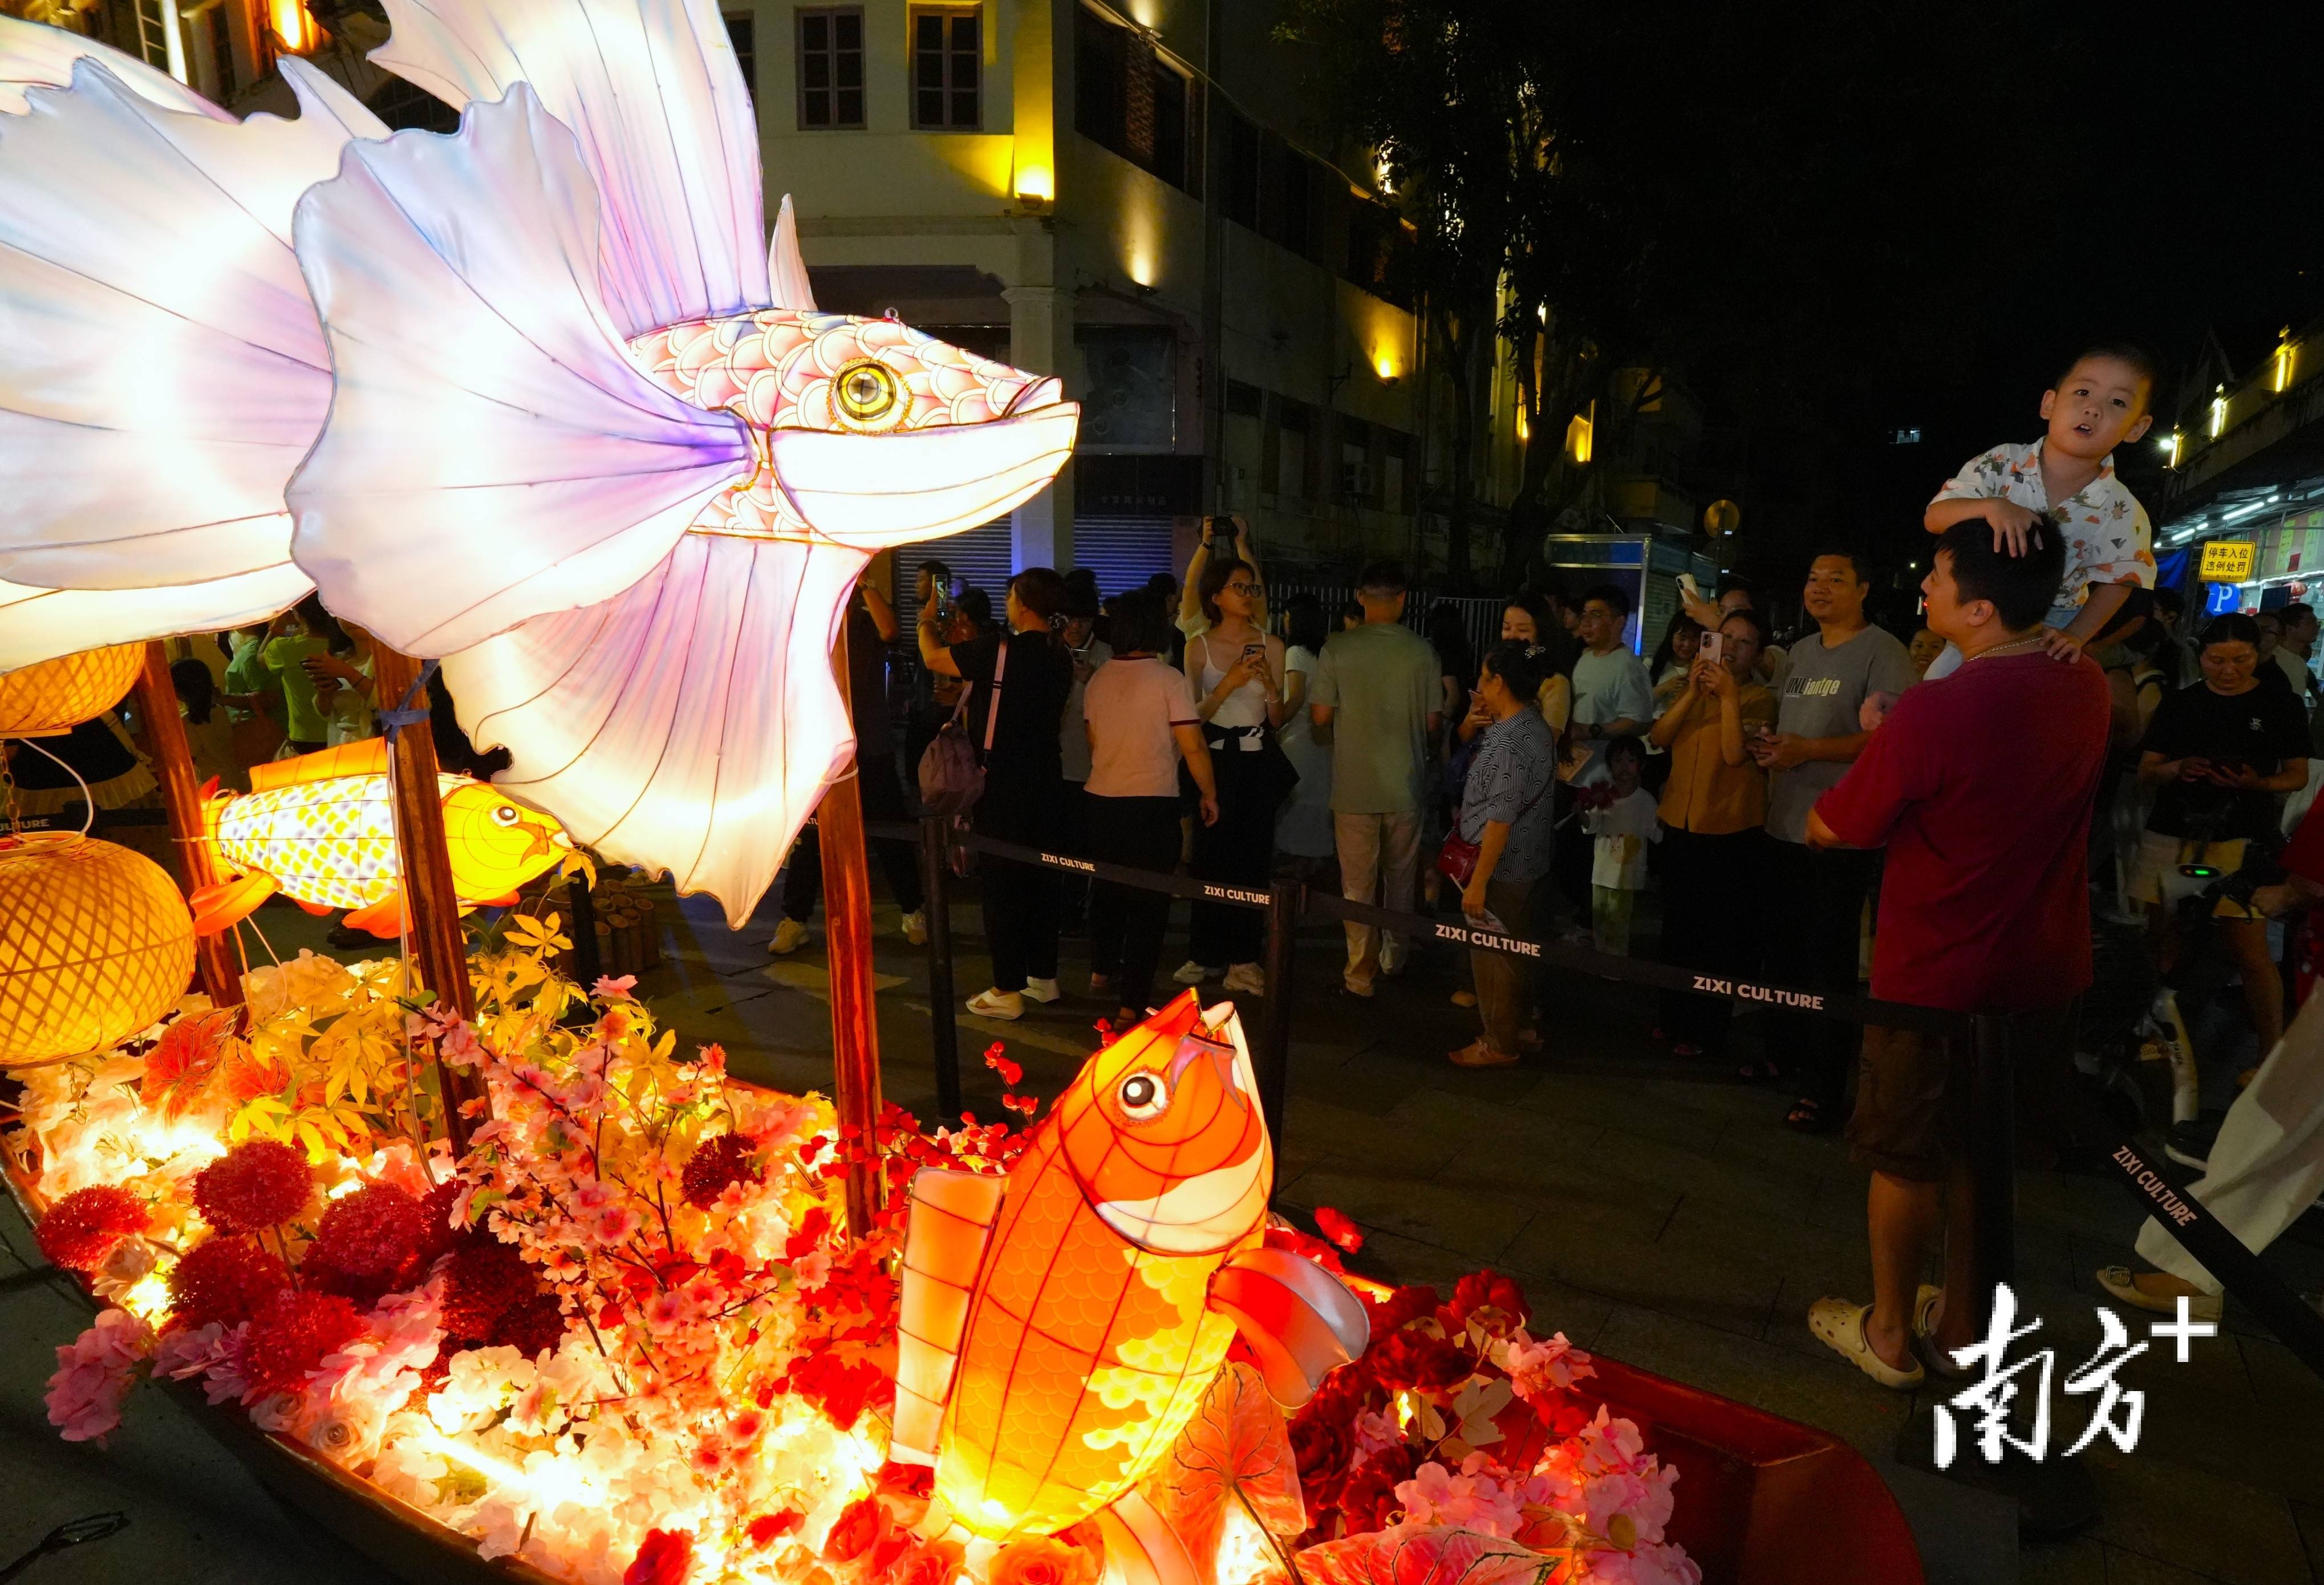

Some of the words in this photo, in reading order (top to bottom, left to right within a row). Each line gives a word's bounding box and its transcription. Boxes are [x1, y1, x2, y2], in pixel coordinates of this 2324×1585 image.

[2208, 546, 2249, 559] 停车入位
[2205, 560, 2246, 573] 违例处罚
[2213, 585, 2233, 612] P
[1040, 853, 1058, 864] ZIXI
[1059, 857, 1096, 872] CULTURE
[1204, 885, 1225, 898] ZIXI
[1226, 889, 1271, 905] CULTURE
[1435, 923, 1467, 942] ZIXI
[1471, 931, 1542, 958] CULTURE
[1693, 976, 1732, 995] ZIXI
[1737, 984, 1824, 1010] CULTURE
[2112, 1145, 2144, 1175] ZIXI
[2136, 1170, 2198, 1227] CULTURE
